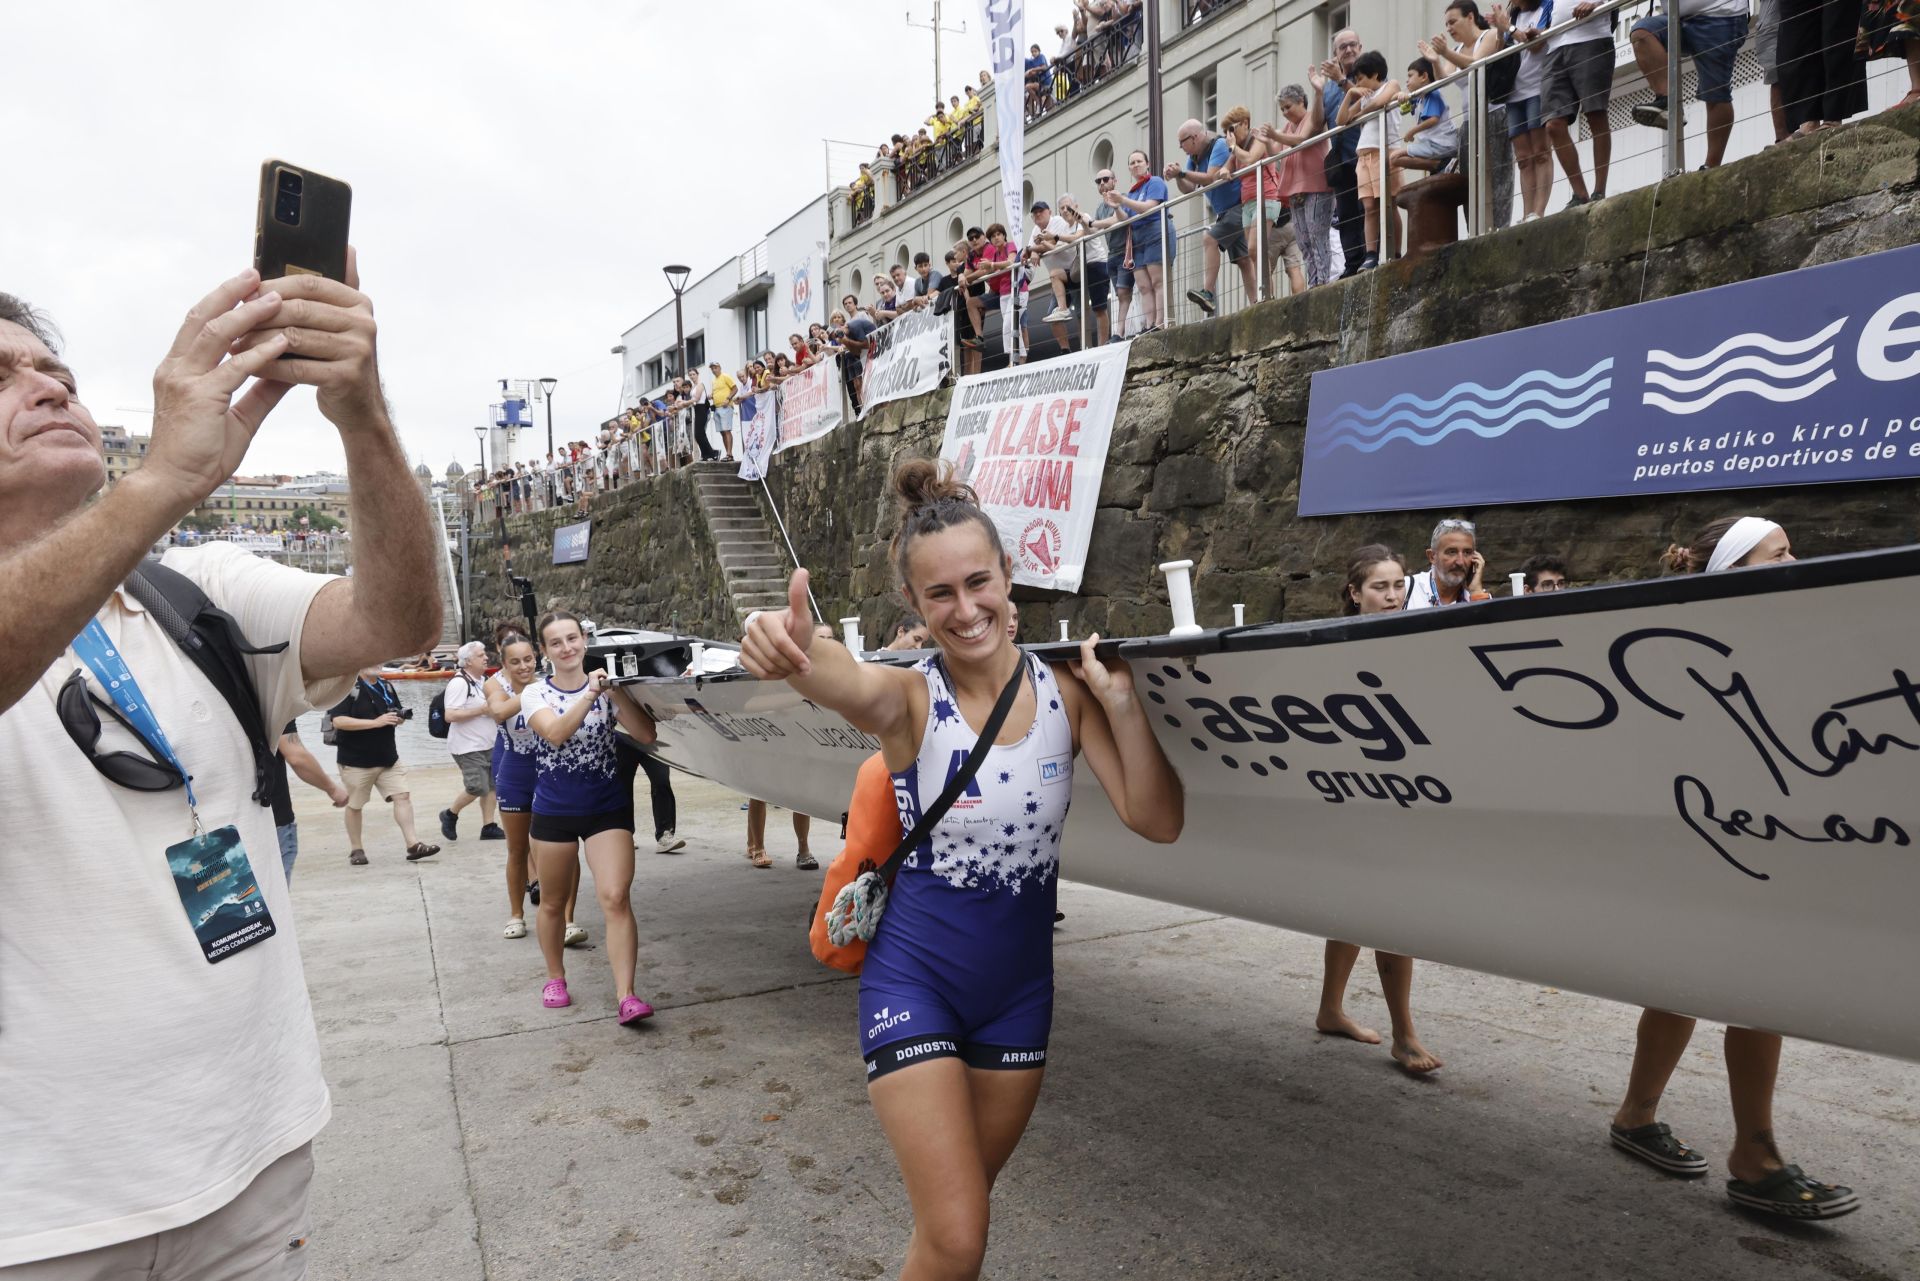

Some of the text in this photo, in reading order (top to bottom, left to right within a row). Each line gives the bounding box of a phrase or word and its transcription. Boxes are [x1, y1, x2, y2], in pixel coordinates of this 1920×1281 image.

[984, 398, 1089, 458] KLASE
[1637, 430, 1775, 457] euskadiko
[1792, 418, 1869, 442] kirol
[1633, 459, 1715, 481] puertos
[1723, 448, 1853, 472] deportivos
[1865, 441, 1897, 461] de
[974, 459, 1073, 512] BATASUNA
[1185, 671, 1432, 762] asegi
[1306, 770, 1453, 808] grupo
[207, 924, 272, 959] MEDIOS COMUNICACIÓN
[211, 920, 262, 948] KOMUNIKABIDEAK
[868, 1010, 911, 1039] amura
[896, 1041, 957, 1062] DONOSTIA
